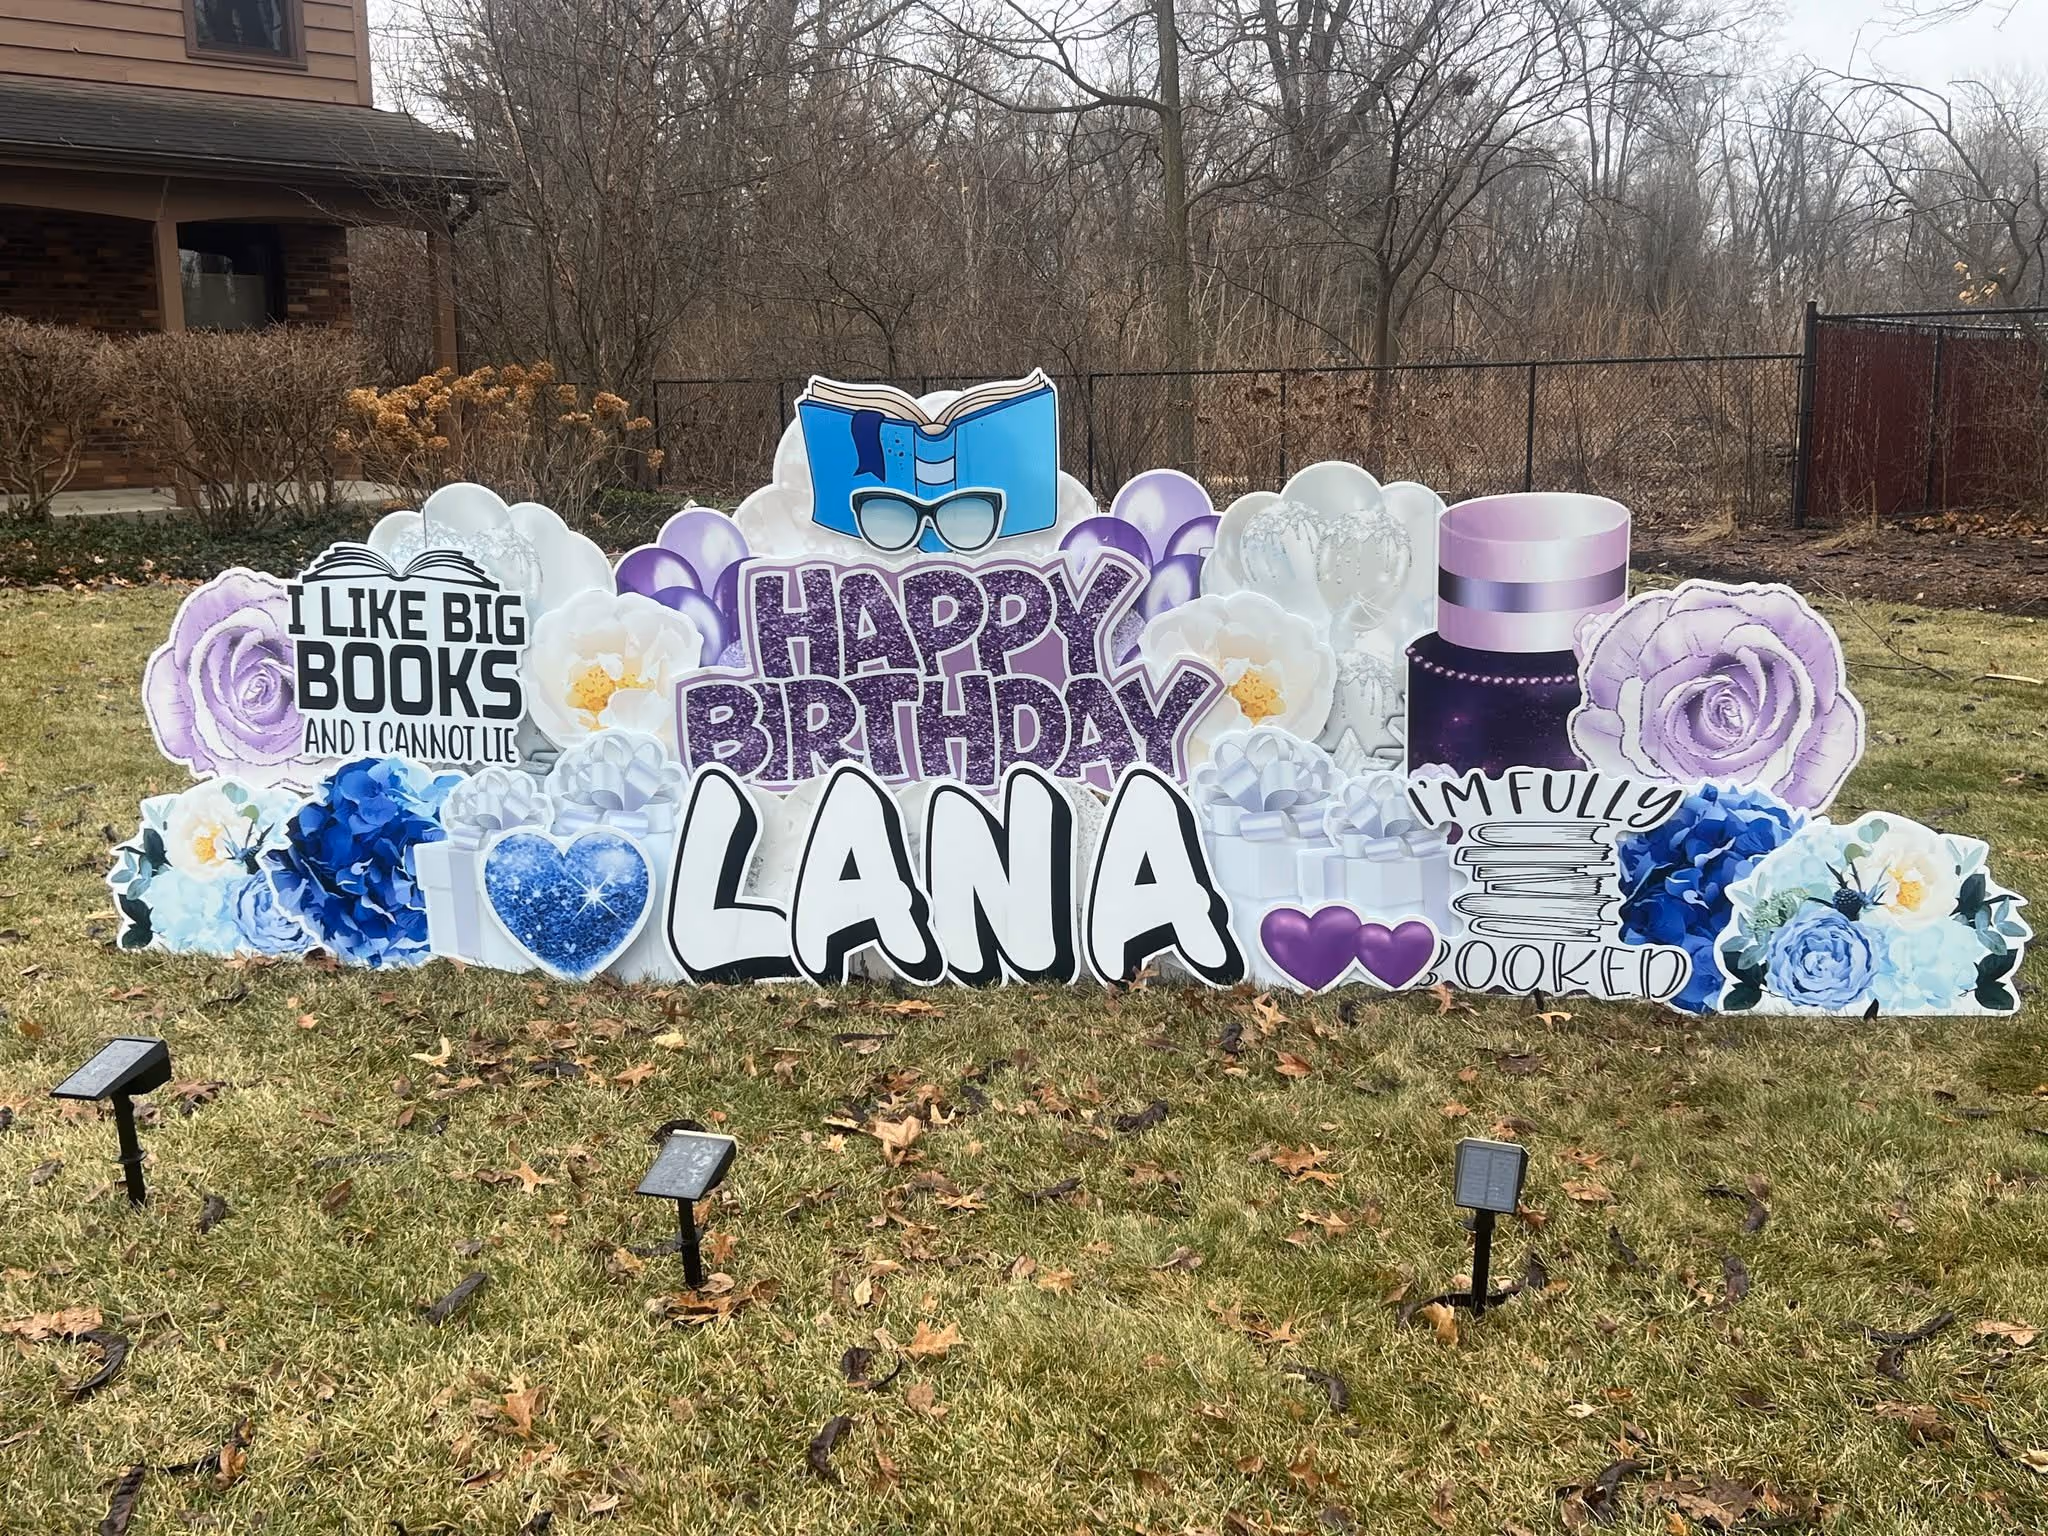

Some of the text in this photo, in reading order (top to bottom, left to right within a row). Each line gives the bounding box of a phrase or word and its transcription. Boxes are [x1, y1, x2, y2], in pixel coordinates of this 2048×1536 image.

[287, 585, 525, 645] I LIKE BIG
[753, 562, 1138, 679] HAPPY
[297, 640, 522, 720] BOOKS
[305, 717, 517, 763] AND I CANNOT LIE
[686, 668, 1213, 787] BIRTHDAY
[1408, 771, 1683, 828] I'M FULLY
[666, 766, 1248, 986] LANA
